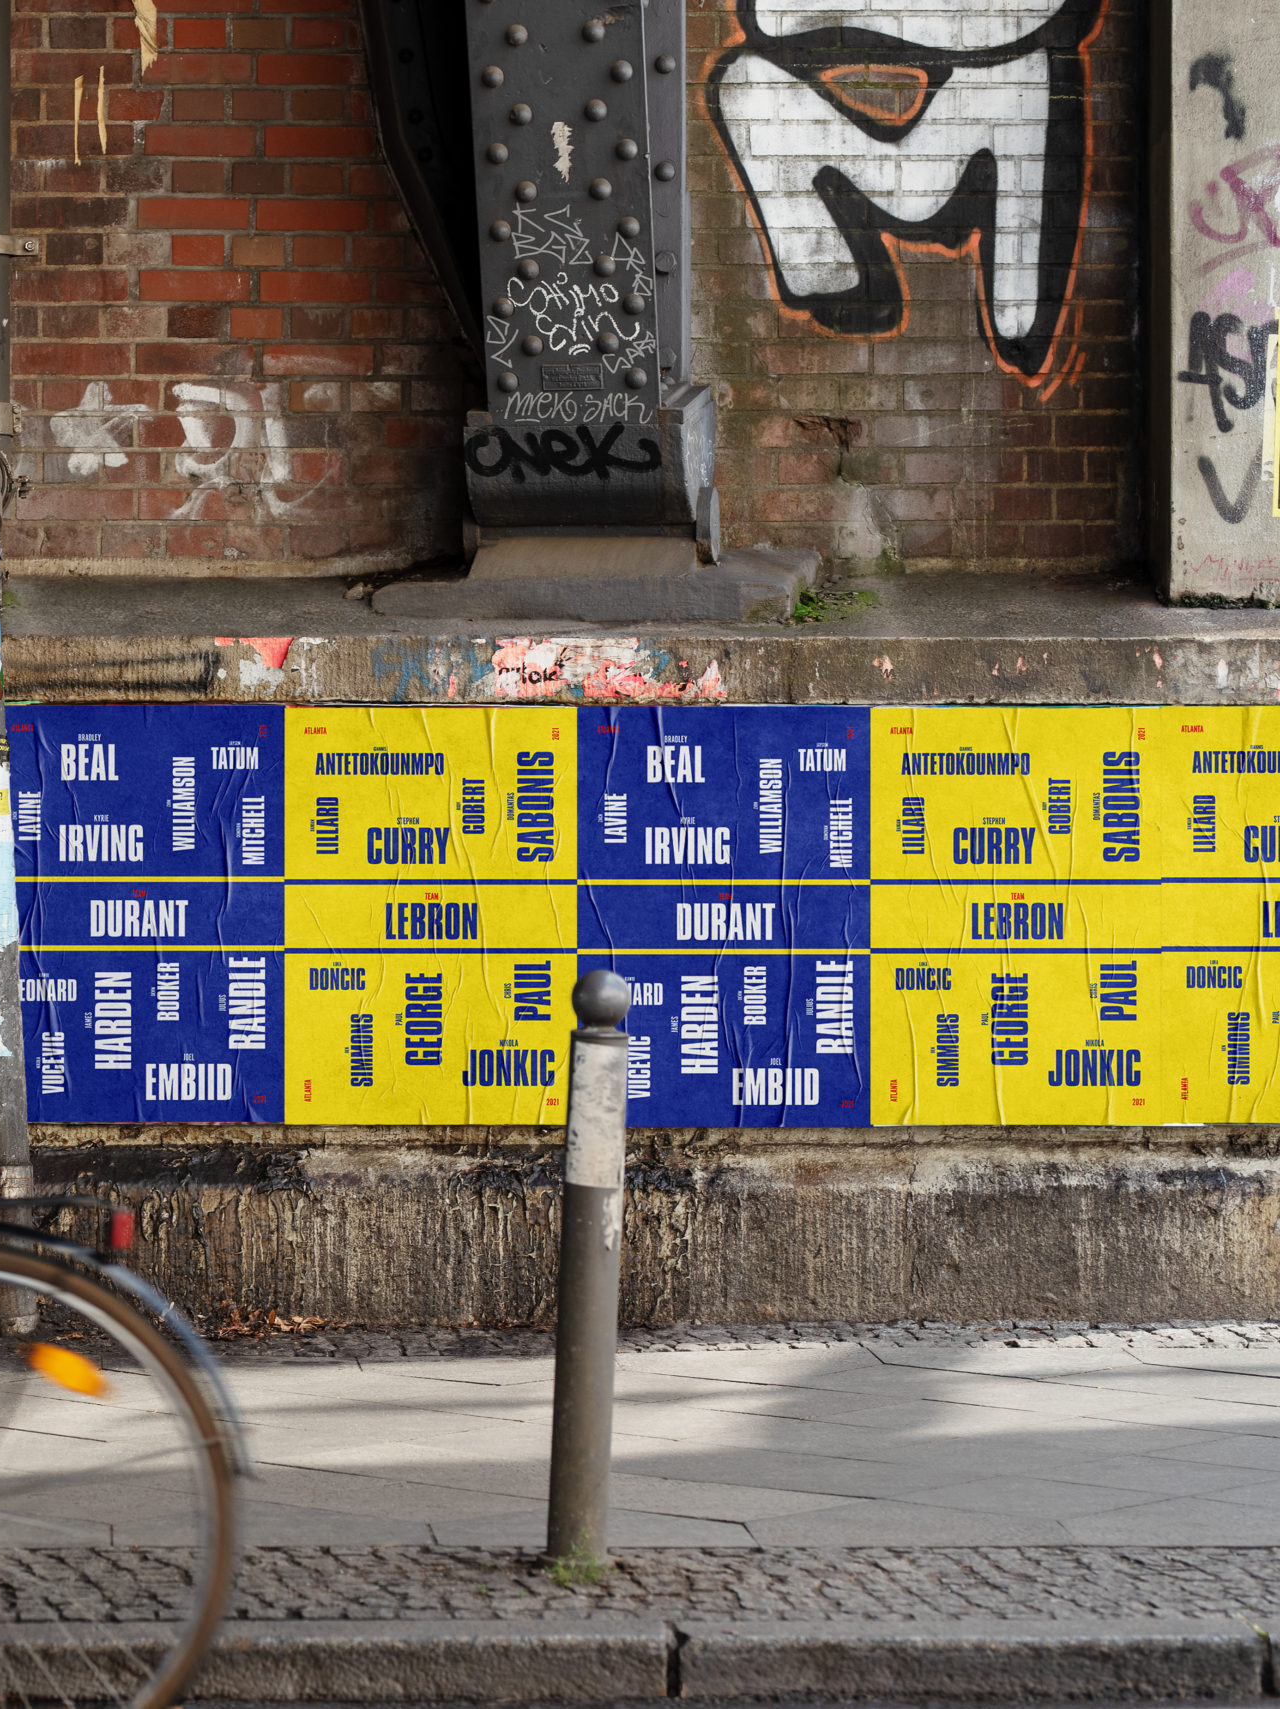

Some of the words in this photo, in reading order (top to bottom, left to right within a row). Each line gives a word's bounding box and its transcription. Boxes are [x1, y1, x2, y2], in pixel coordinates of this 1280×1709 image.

[78, 734, 101, 742] BRADLEY
[665, 735, 687, 743] BRADLEY
[61, 744, 119, 781] BEAL
[211, 747, 259, 770] TATUM
[316, 752, 444, 775] ANTETOKOUNMPO
[647, 745, 705, 783] BEAL
[799, 749, 846, 771] TATUM
[902, 752, 1030, 775] ANTETOKOUNMPO
[1193, 750, 1280, 773] ANTETOKOU
[19, 791, 41, 841] LAVINE
[173, 756, 195, 851] WILLIAMSON
[397, 817, 419, 825] STEPHEN
[462, 778, 484, 834] GOBERT
[517, 751, 554, 862] SABONIS
[604, 794, 627, 843] LAVINE
[760, 759, 782, 854] WILLIAMSON
[983, 817, 1005, 825] STEPHEN
[1048, 778, 1070, 834] GOBERT
[1103, 751, 1140, 862] SABONIS
[242, 795, 264, 865] MITCHELL
[316, 797, 338, 854] LILLARD
[830, 798, 852, 868] MITCHELL
[902, 797, 924, 854] LILLARD
[1193, 795, 1215, 852] LILLARD
[59, 824, 144, 862] IRVING
[367, 827, 449, 864] CURRY
[646, 827, 730, 865] IRVING
[953, 827, 1035, 864] CURRY
[90, 900, 189, 937] DURANT
[386, 903, 477, 940] LEBRON
[677, 903, 775, 941] DURANT
[972, 903, 1063, 940] LEBRON
[18, 979, 77, 1002] EONARD
[157, 962, 180, 1021] BOOKER
[310, 968, 365, 991] DONCIC
[514, 961, 551, 1021] PAUL
[744, 966, 766, 1025] BOOKER
[896, 968, 951, 991] DONCIC
[1100, 961, 1137, 1021] PAUL
[1187, 966, 1242, 989] DONCIC
[95, 971, 132, 1069] HARDEN
[228, 956, 266, 1049] RANDLE
[405, 973, 442, 1065] GEORGE
[816, 960, 853, 1054] RANDLE
[991, 973, 1028, 1065] GEORGE
[499, 1039, 518, 1047] NIKOLA
[681, 975, 718, 1074] HARDEN
[1085, 1039, 1104, 1047] NIKOLA
[42, 1032, 65, 1094] VUCEVIC
[183, 1053, 194, 1061] JOEL
[351, 1013, 373, 1087] SIMMONS
[628, 1036, 651, 1098] VUCEVIC
[937, 1013, 959, 1087] SIMMONS
[1228, 1011, 1250, 1085] SIMMONS
[145, 1063, 232, 1101] EMBIID
[462, 1049, 555, 1087] JONKIC
[732, 1068, 819, 1105] EMBIID
[1048, 1049, 1141, 1087] JONKIC
